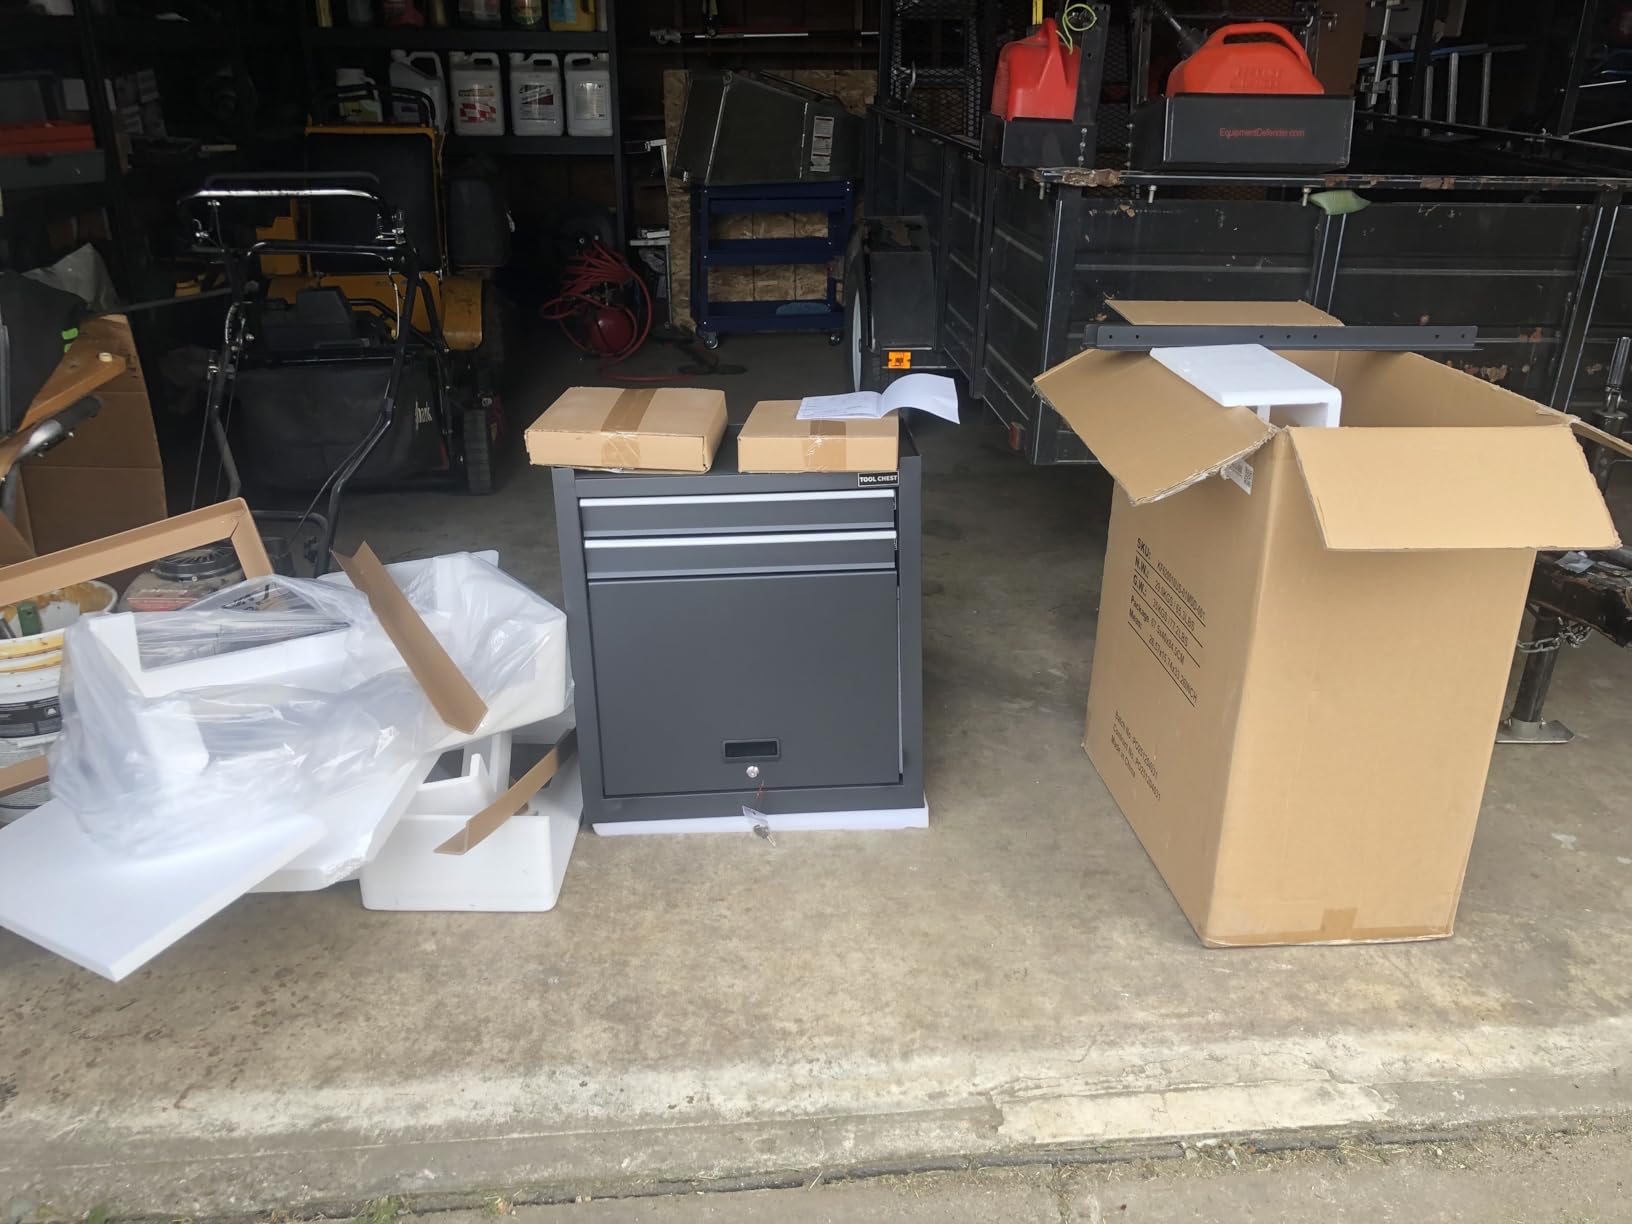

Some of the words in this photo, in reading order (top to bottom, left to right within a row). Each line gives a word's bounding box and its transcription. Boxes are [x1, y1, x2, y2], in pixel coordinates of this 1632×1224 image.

[1219, 128, 1305, 139] EquipmentDefender.com
[1136, 537, 1151, 560] SKU:
[1130, 594, 1150, 620] Package
[1111, 734, 1120, 753] Made
[1124, 755, 1136, 778] China
